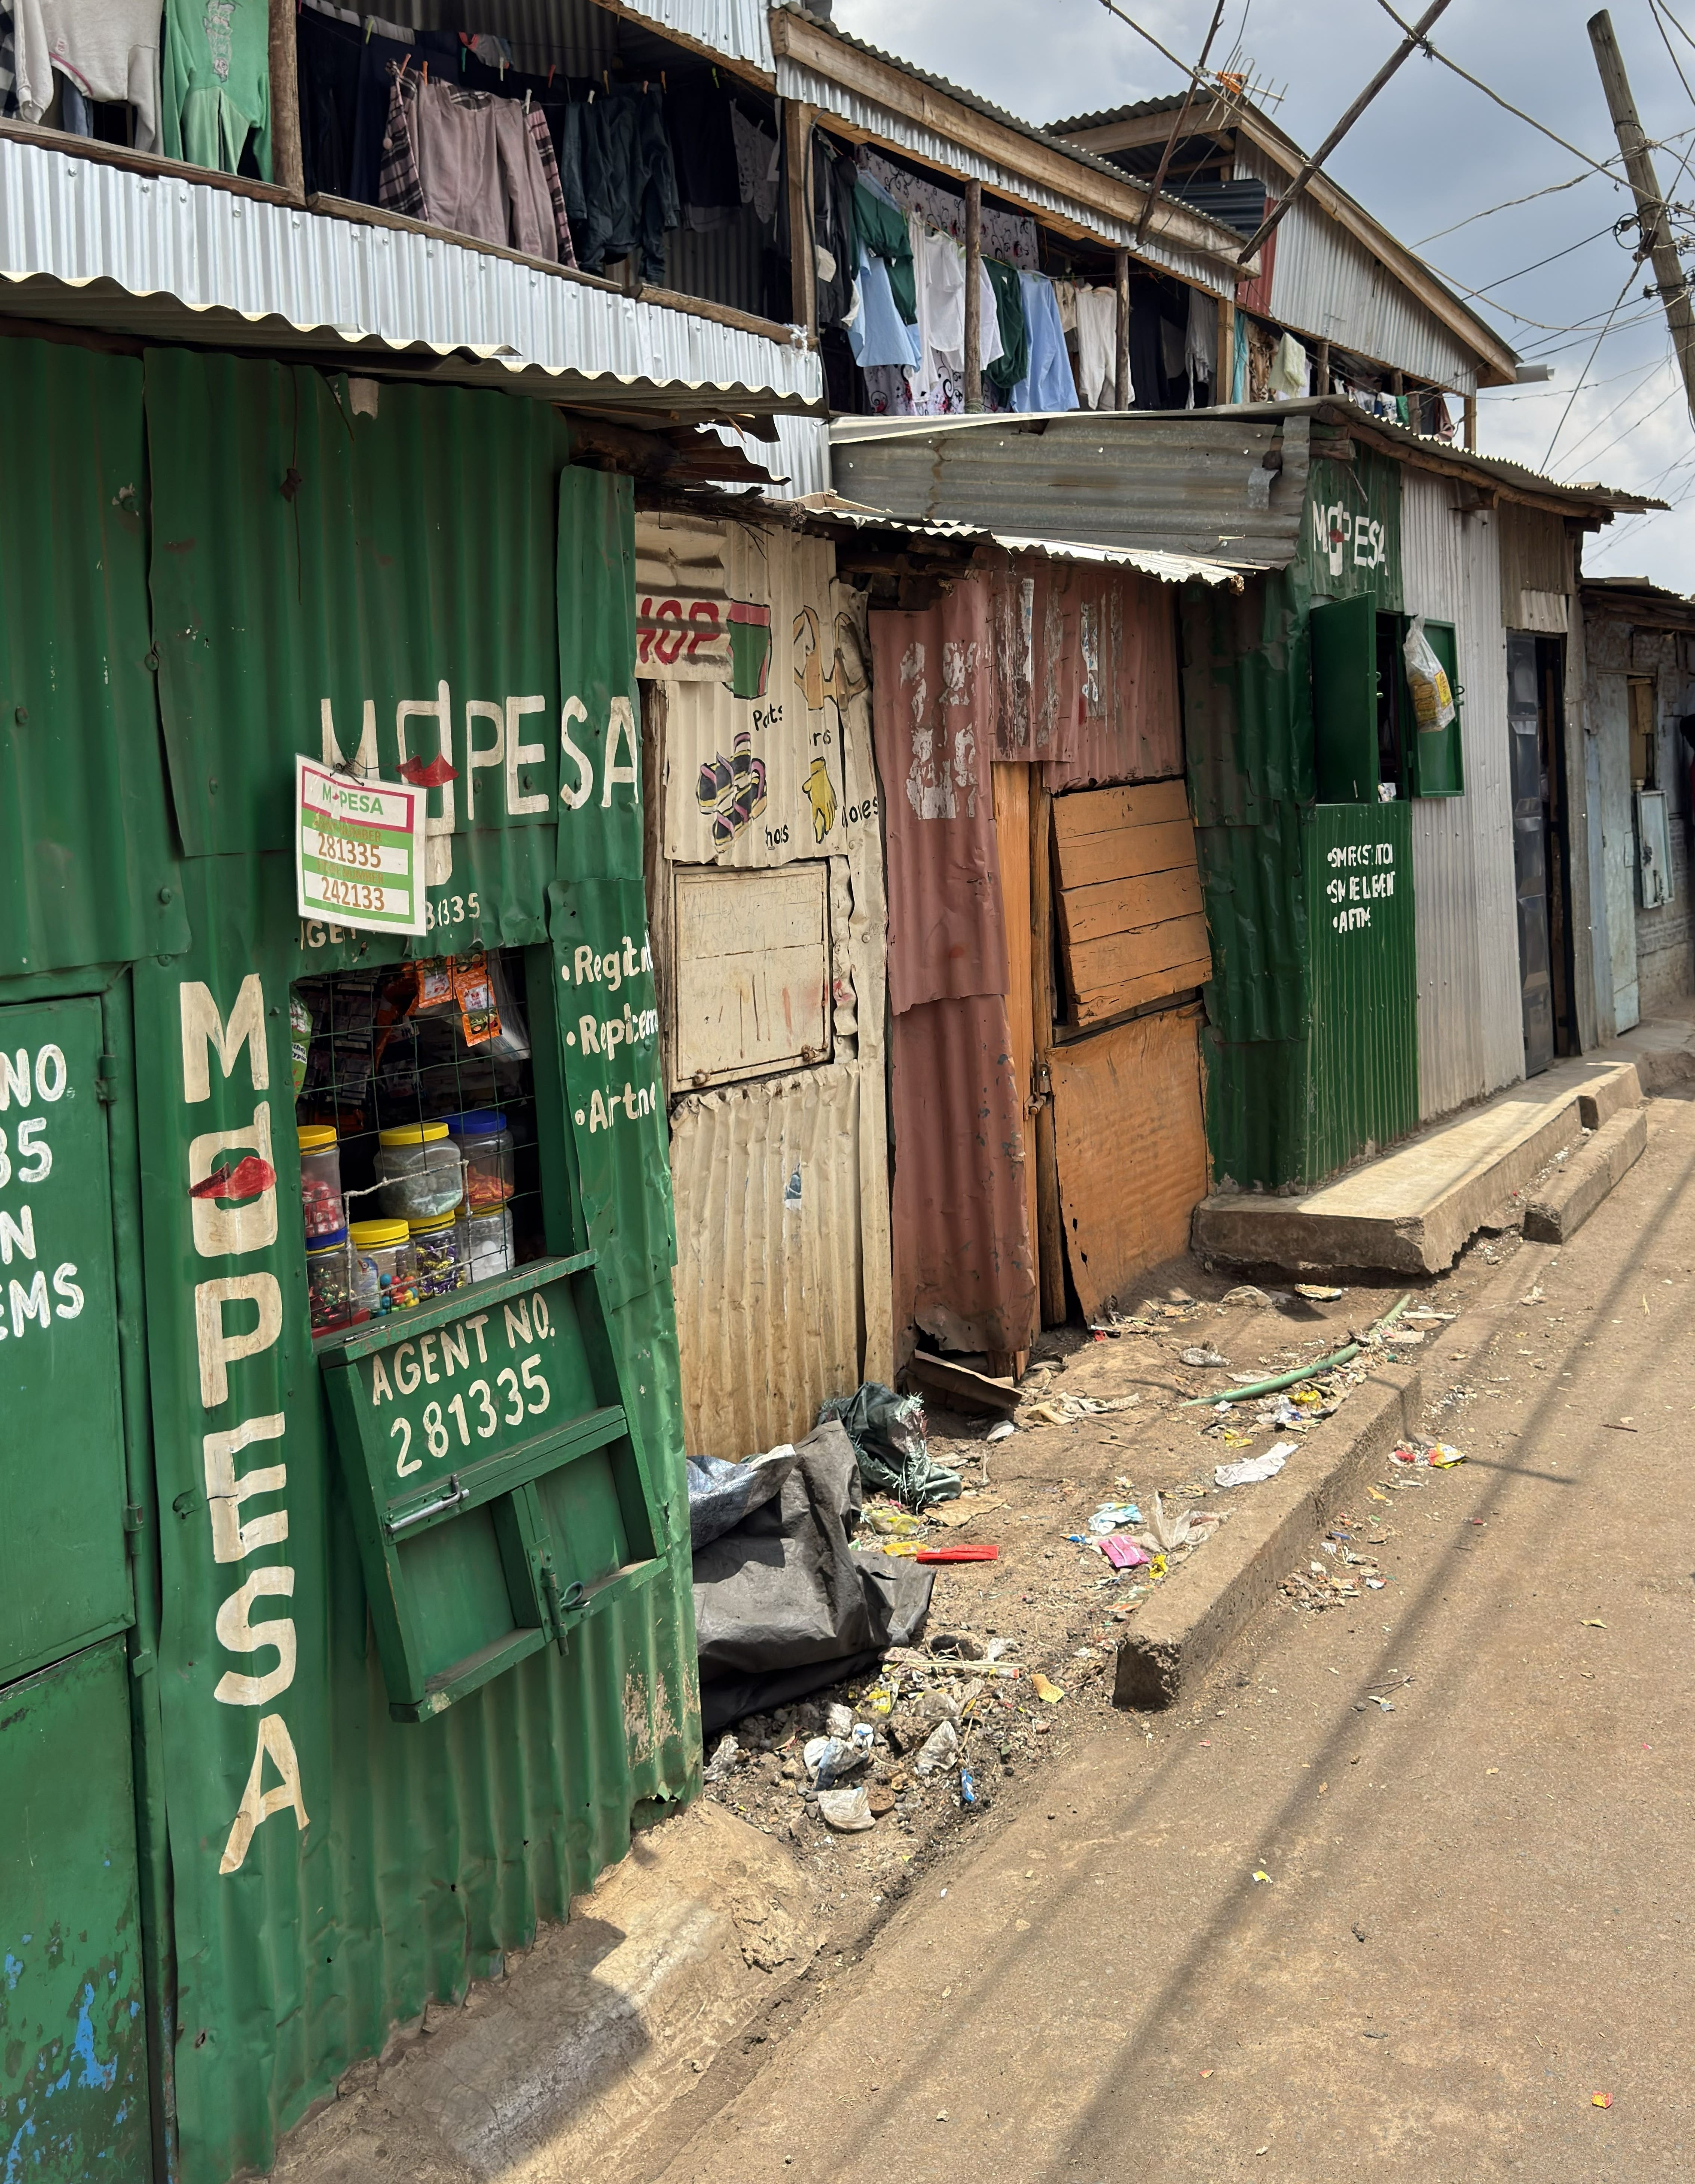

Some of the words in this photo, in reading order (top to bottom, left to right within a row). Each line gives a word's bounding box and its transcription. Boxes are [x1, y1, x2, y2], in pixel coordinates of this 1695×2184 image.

[318, 832, 381, 868] 281335
[321, 876, 385, 911] 242133
[372, 1314, 489, 1406] AGENT
[503, 1292, 555, 1349] NO.
[390, 1353, 550, 1478] 281335
